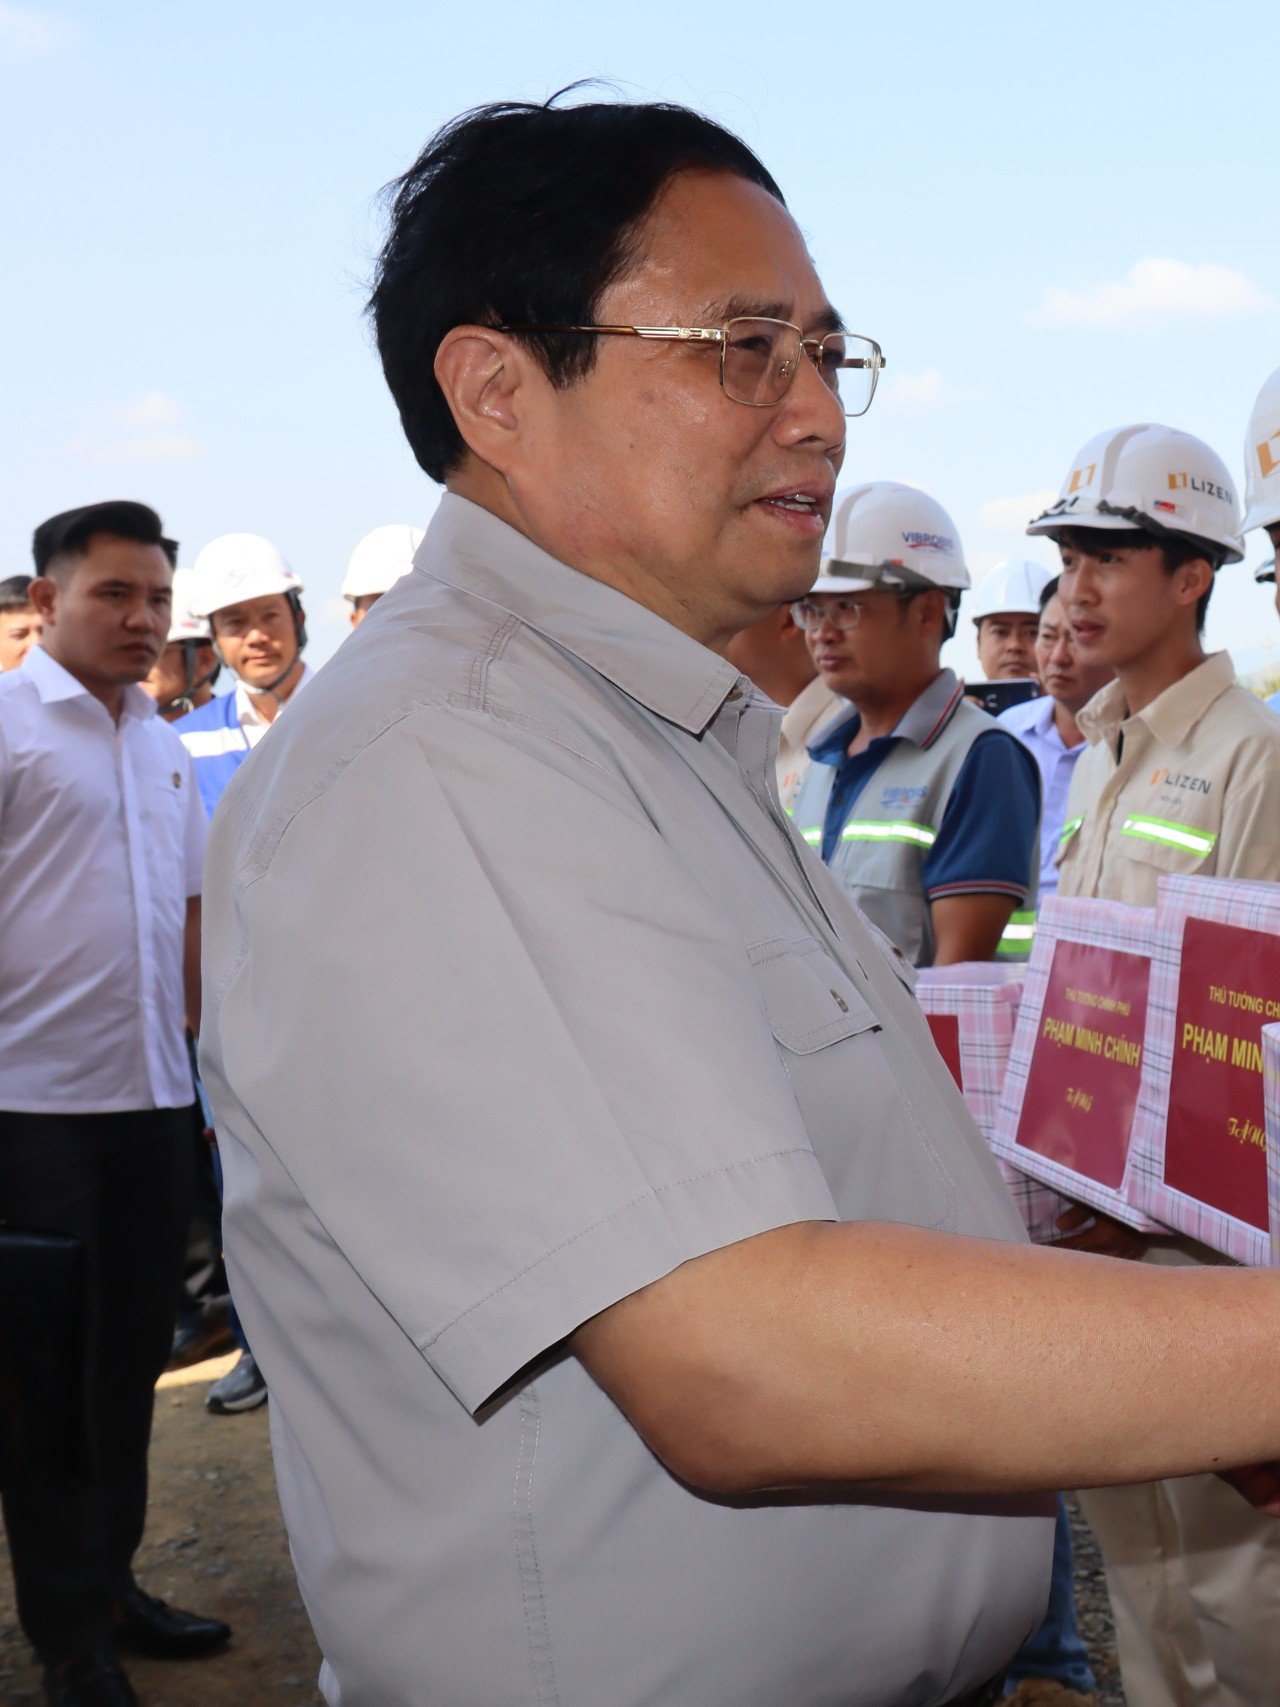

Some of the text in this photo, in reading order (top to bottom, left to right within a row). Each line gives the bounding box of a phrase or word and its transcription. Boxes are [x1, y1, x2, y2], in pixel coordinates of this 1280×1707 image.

[1191, 478, 1232, 504] LIZEN
[1166, 775, 1211, 794] LIZEN
[1228, 990, 1264, 1014] TƯỚNG
[1042, 1017, 1141, 1068] PHẠM MINH CHÍNH
[1182, 1022, 1264, 1073] PHẠM MIN
